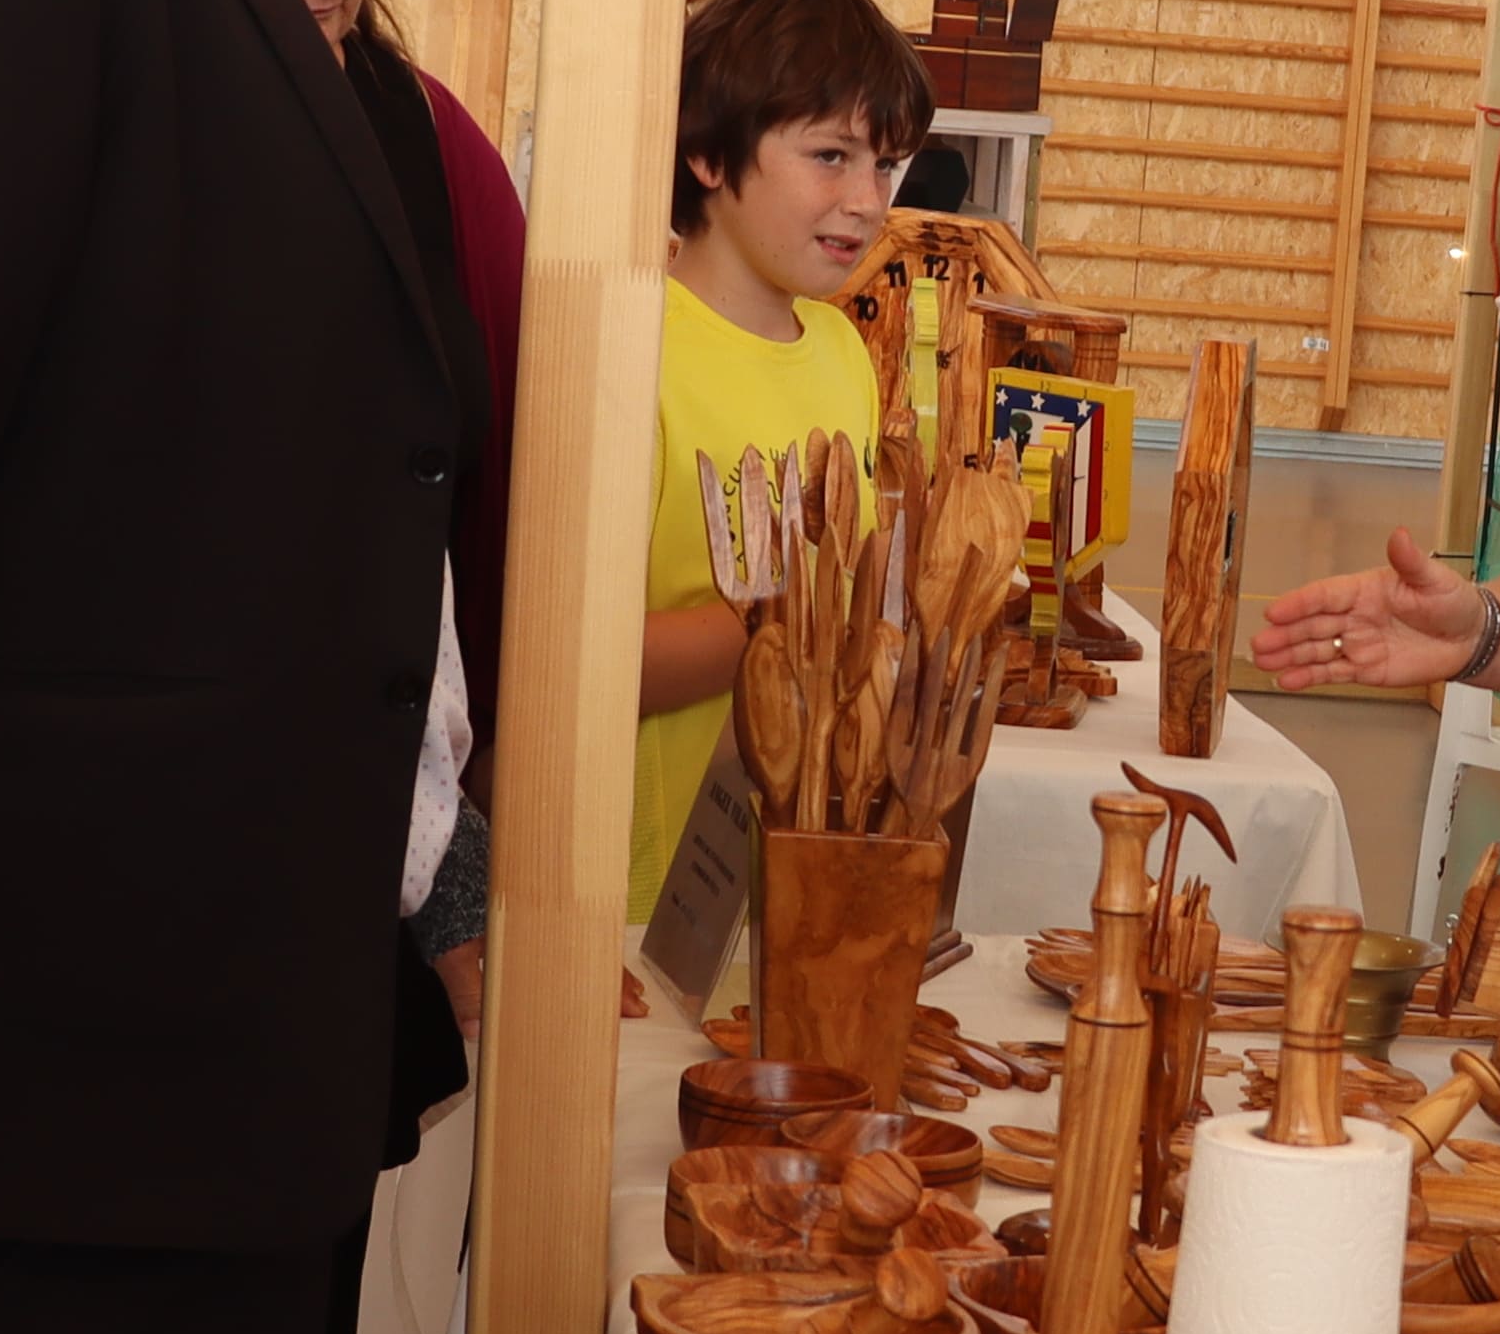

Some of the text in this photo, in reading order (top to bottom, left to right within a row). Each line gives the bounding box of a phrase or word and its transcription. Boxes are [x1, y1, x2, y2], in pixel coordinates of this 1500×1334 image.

[884, 261, 906, 287] 11
[924, 254, 949, 281] 12
[972, 271, 985, 294] 1
[854, 294, 878, 321] 10
